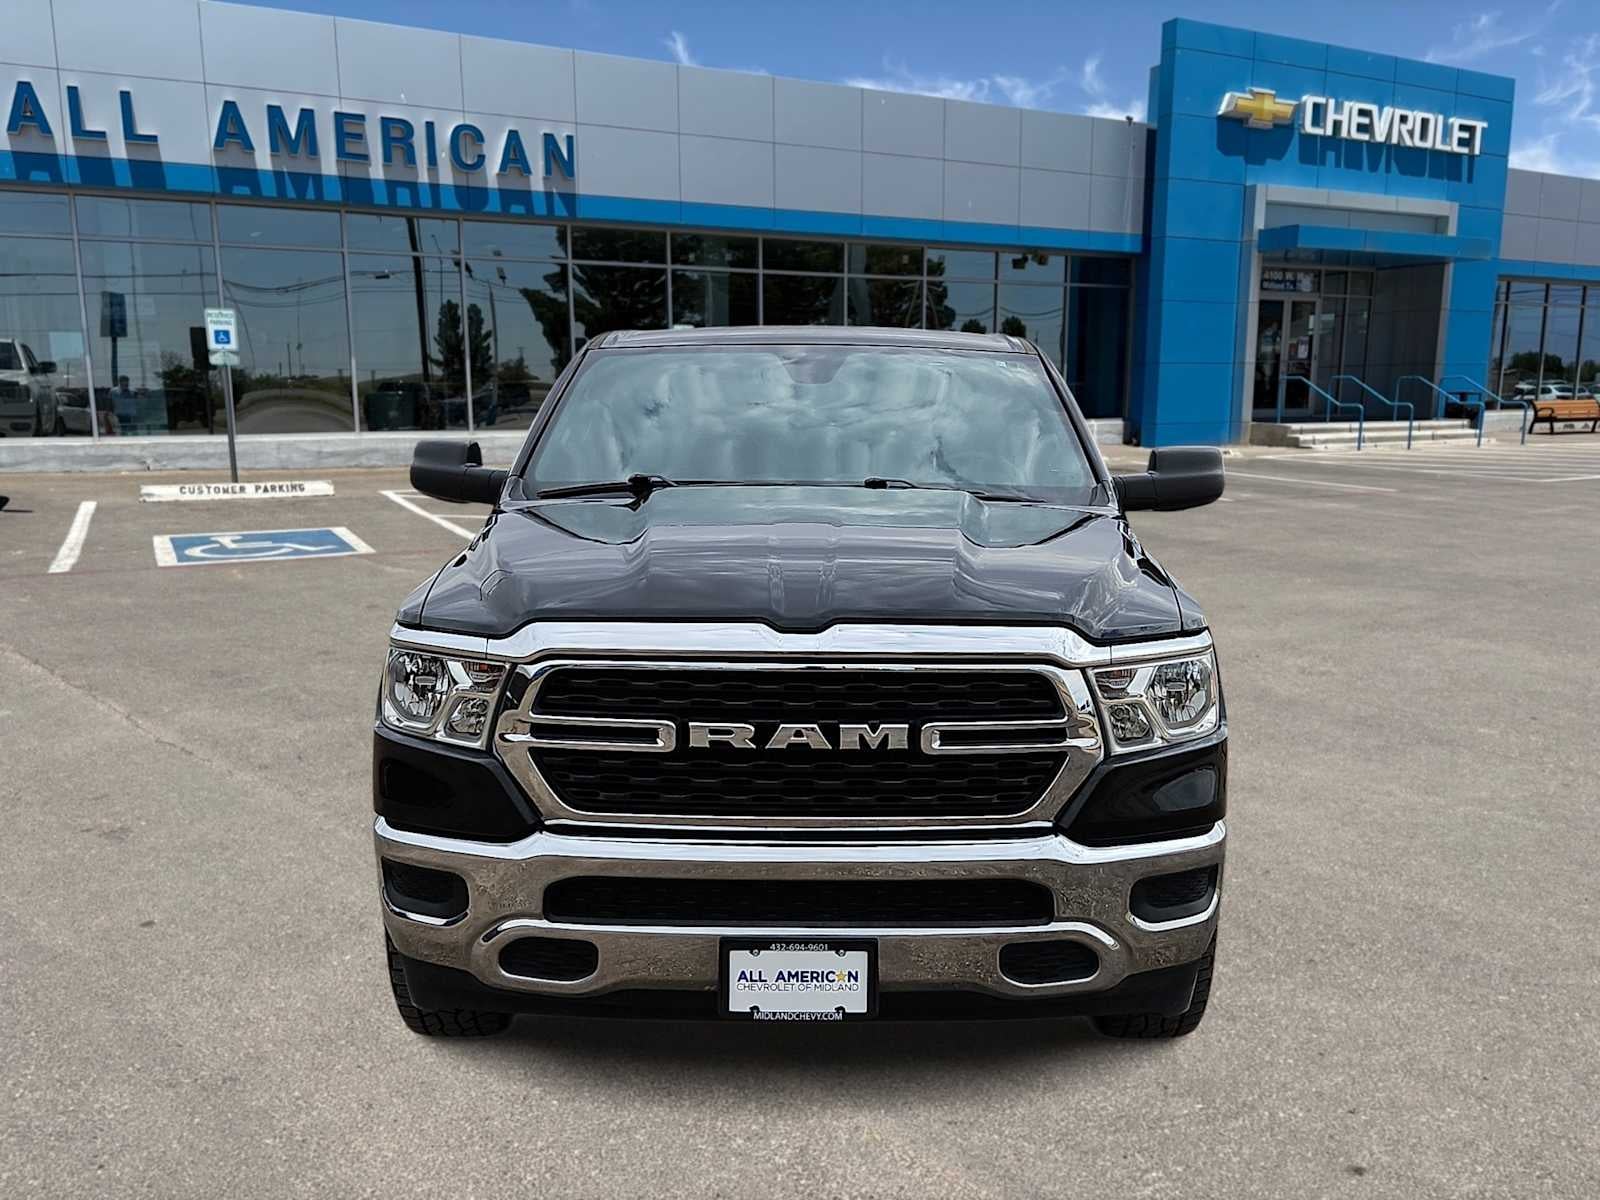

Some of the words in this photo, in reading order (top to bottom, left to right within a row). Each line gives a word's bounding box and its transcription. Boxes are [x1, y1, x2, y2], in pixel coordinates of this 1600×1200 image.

[6, 80, 158, 144] ALL
[213, 99, 575, 178] AMERICAN
[1301, 94, 1488, 155] CHEVROLET
[179, 485, 247, 495] CUSTOMER
[254, 483, 306, 494] PARKING
[688, 721, 909, 750] RAM
[769, 943, 829, 951] 432-694-9601
[737, 970, 768, 983] ALL
[736, 983, 795, 992] CHEVROLET
[797, 983, 812, 992] OF
[813, 983, 859, 992] MIDLAND
[752, 1011, 843, 1021] MIDLANDCHEVY.COM
